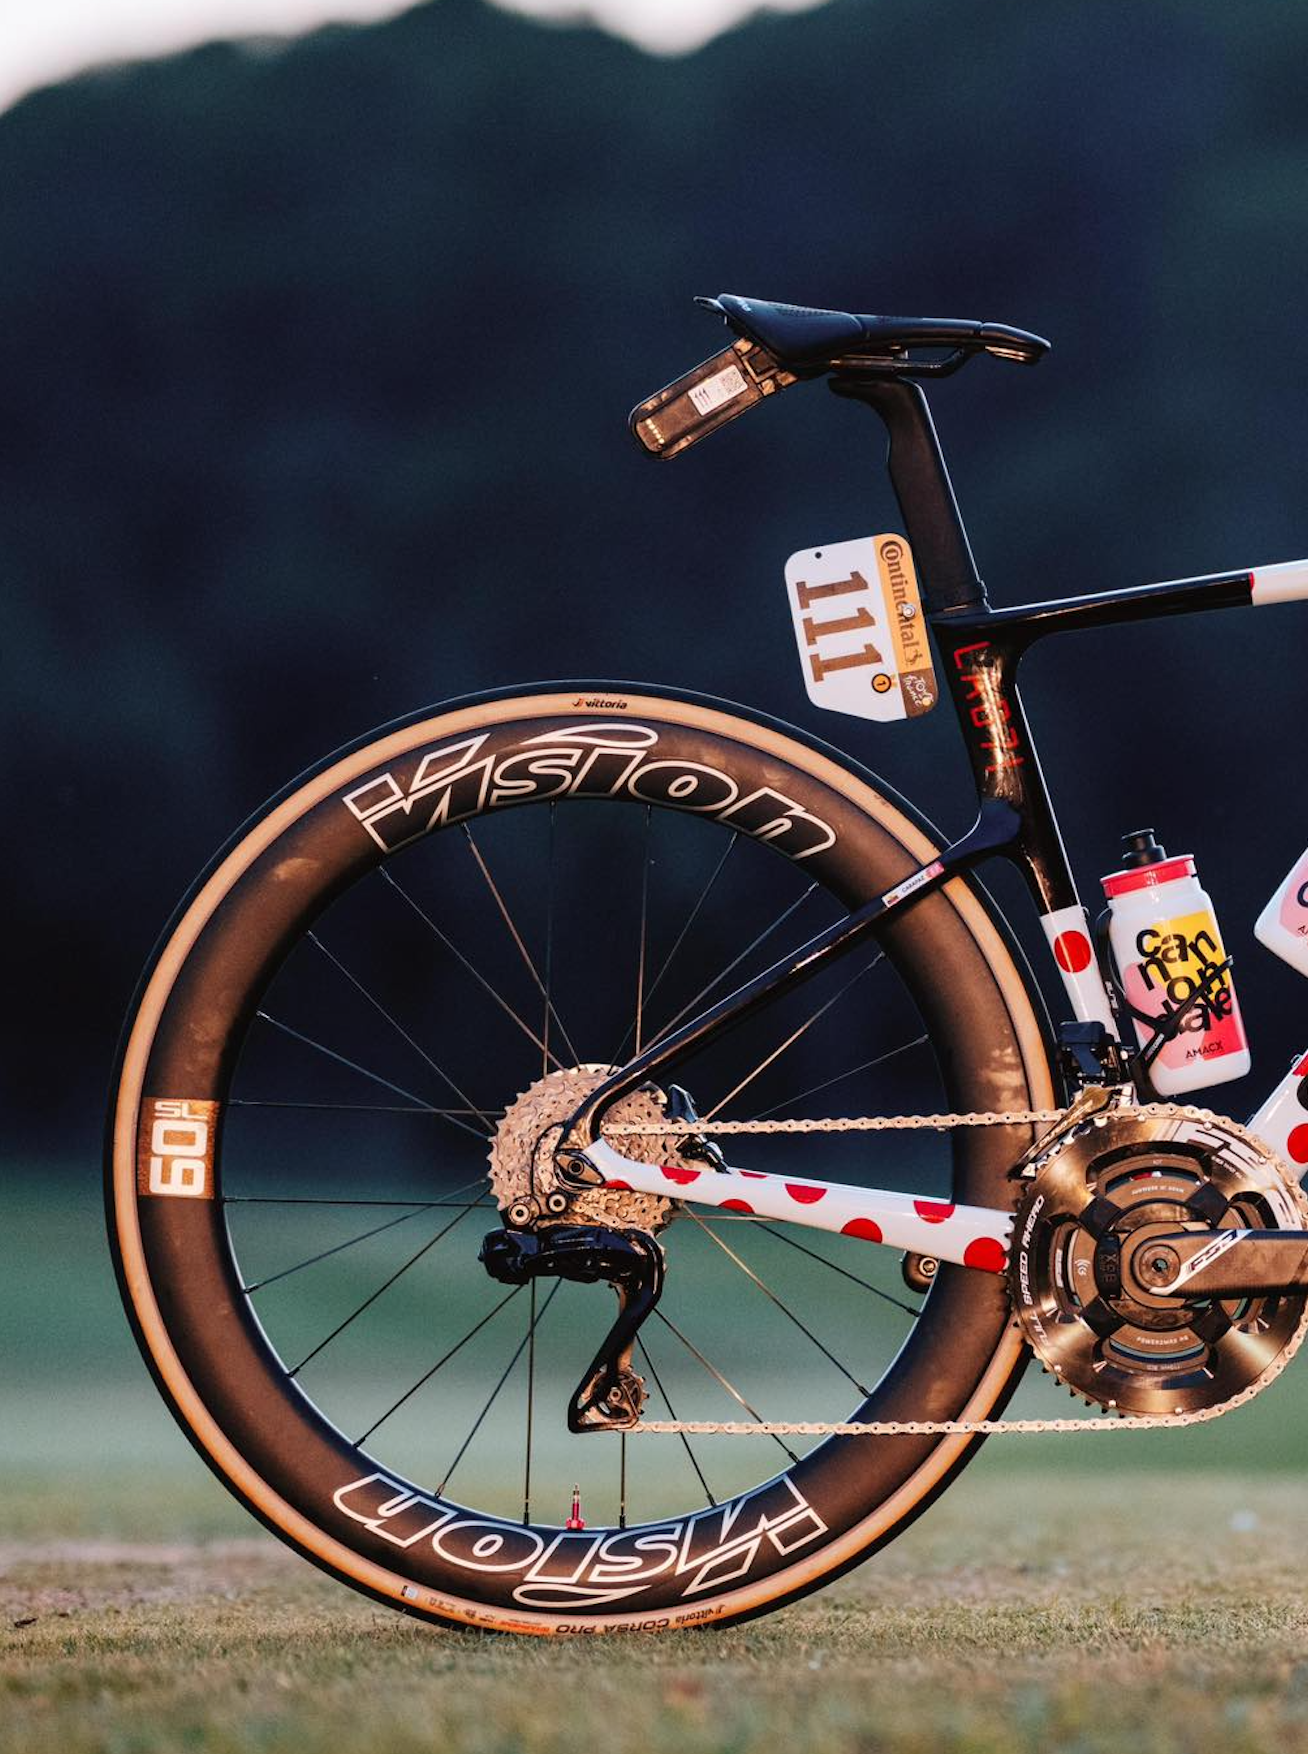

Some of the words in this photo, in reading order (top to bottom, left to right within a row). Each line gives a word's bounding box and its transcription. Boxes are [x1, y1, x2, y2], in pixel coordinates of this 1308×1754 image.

[796, 571, 883, 682] 111
[585, 698, 627, 709] vittoria
[342, 723, 836, 859] Vision
[1185, 1040, 1224, 1059] AMACX
[154, 1101, 208, 1120] SL
[149, 1119, 208, 1196] 60
[1021, 1194, 1045, 1249] AHEAD
[1019, 1251, 1034, 1306] SPEED
[332, 1472, 829, 1608] Vision
[556, 1624, 597, 1635] PRO
[604, 1618, 670, 1633] CORSA
[675, 1607, 714, 1624] vittoria
